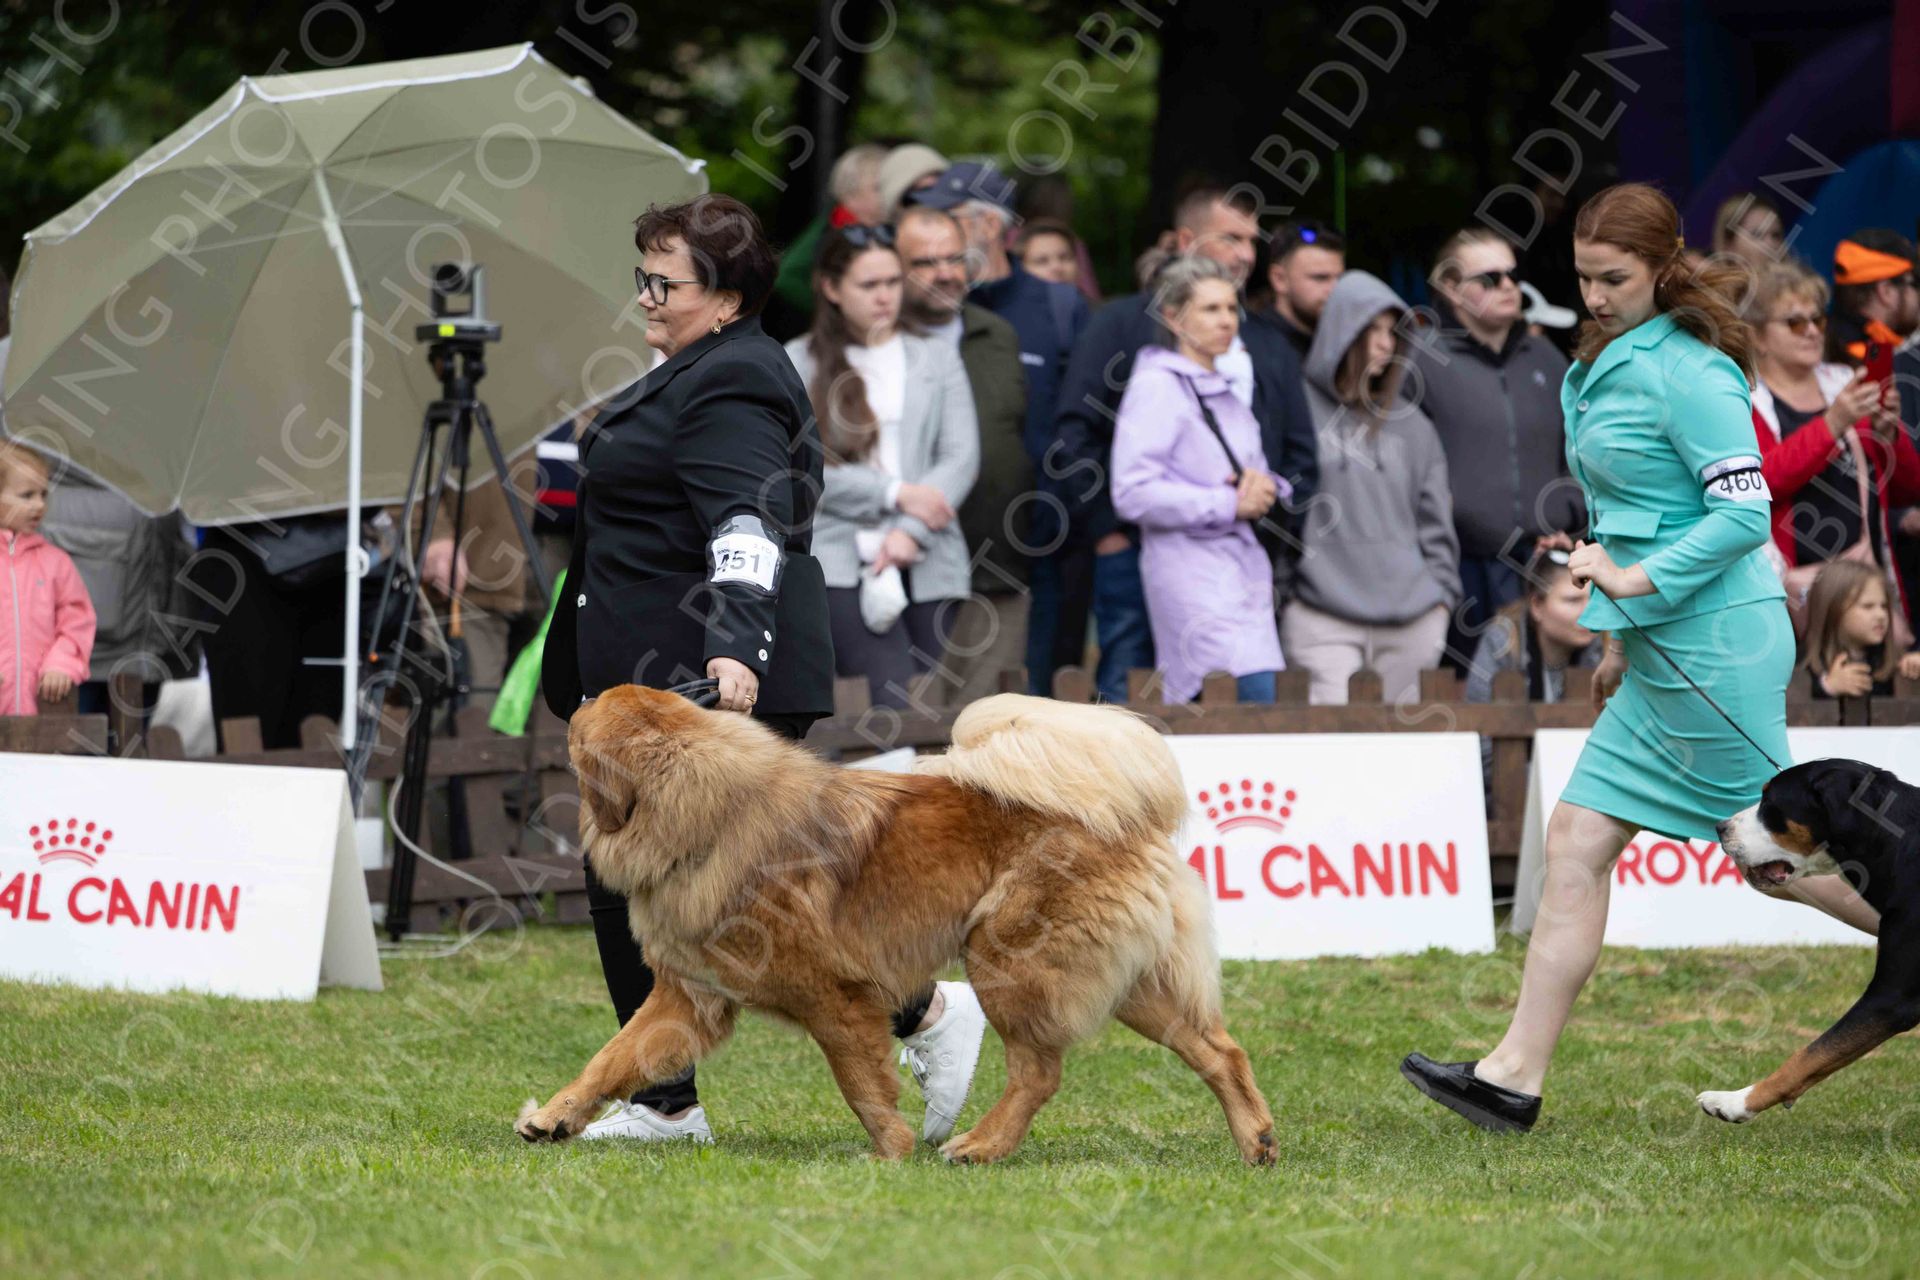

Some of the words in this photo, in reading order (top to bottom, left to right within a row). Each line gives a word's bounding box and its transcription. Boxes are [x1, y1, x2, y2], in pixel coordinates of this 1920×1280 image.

[1720, 470, 1762, 495] 460
[1261, 842, 1459, 898] CANIN
[67, 876, 240, 934] CANIN
